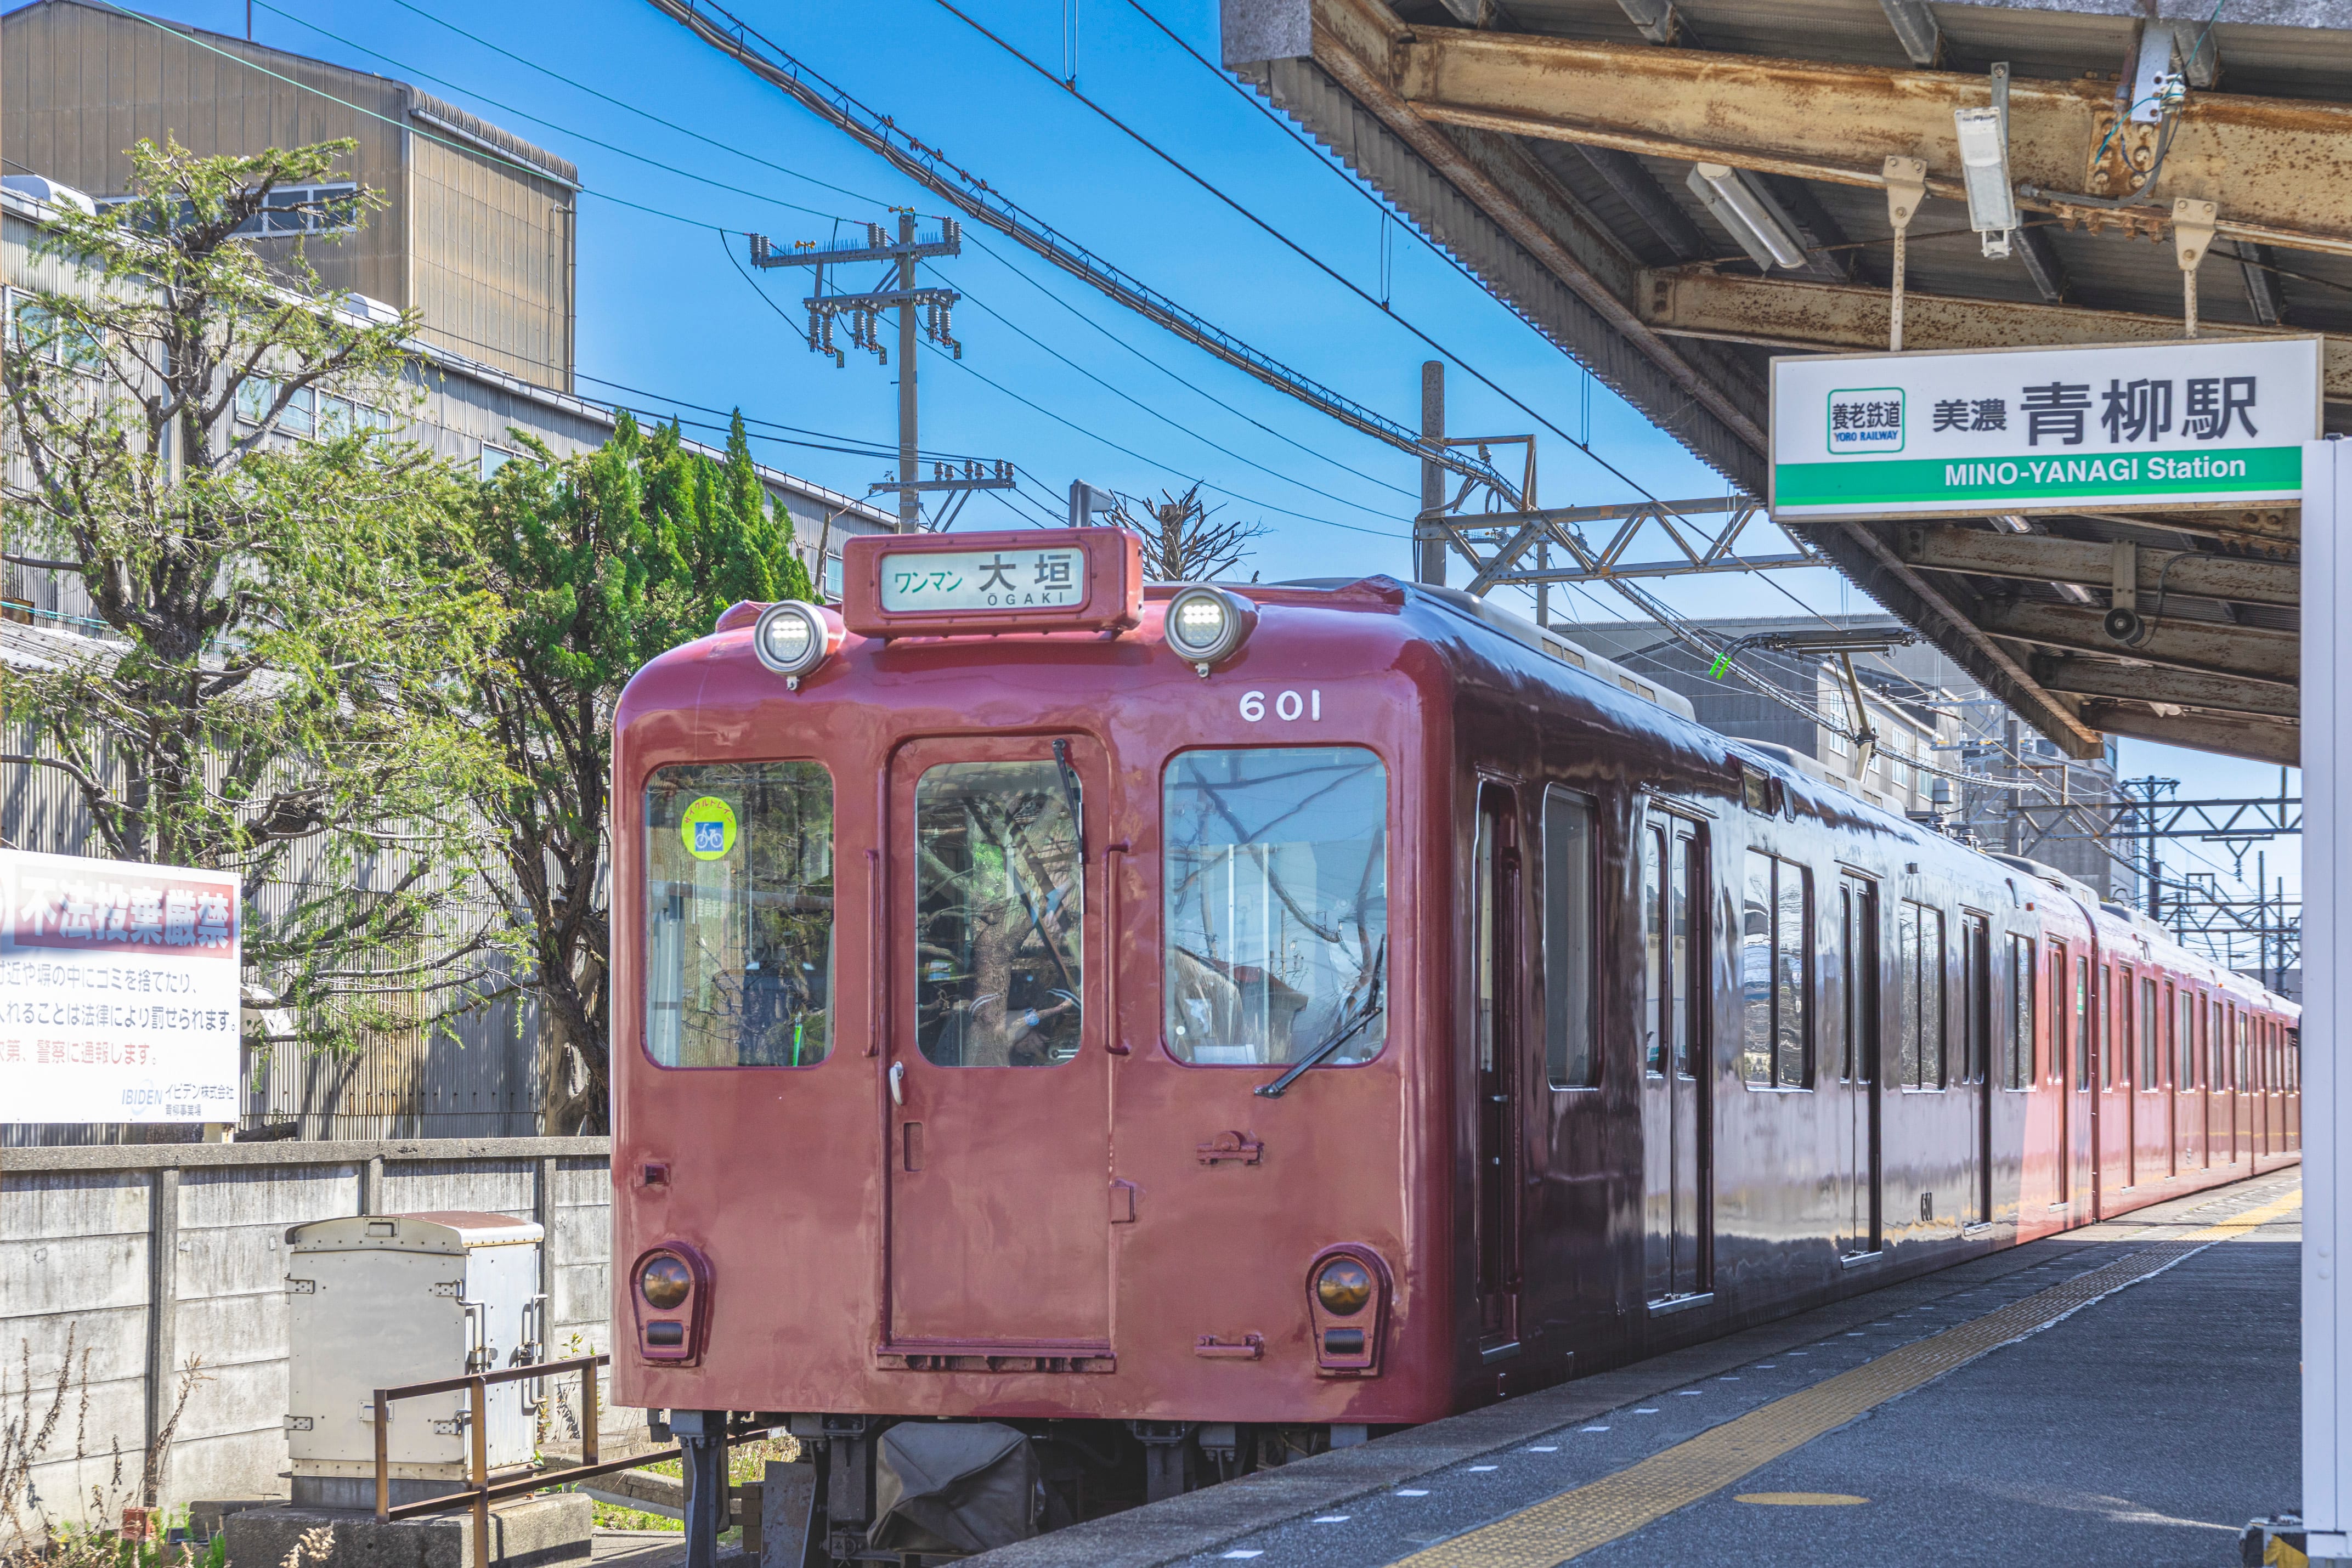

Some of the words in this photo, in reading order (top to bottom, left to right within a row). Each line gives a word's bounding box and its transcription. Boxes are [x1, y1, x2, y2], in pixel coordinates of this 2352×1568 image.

[1833, 401, 1901, 430] 養老鉄道
[1933, 398, 2007, 432] 美濃
[2021, 376, 2258, 446] 青柳駅
[1834, 432, 1857, 442] YORO
[1860, 431, 1898, 441] RAILWAY
[1945, 458, 2138, 486] MINO-YANAGI
[2147, 456, 2246, 480] Station
[895, 571, 963, 593] ワンマン
[979, 554, 1072, 592] 大垣
[1239, 689, 1320, 722] 601
[685, 799, 733, 824] サイクルトレイン
[20, 876, 229, 949] 不法投棄厳禁
[122, 1089, 162, 1105] IBIDEN
[165, 1083, 234, 1099] イビデン株式会社
